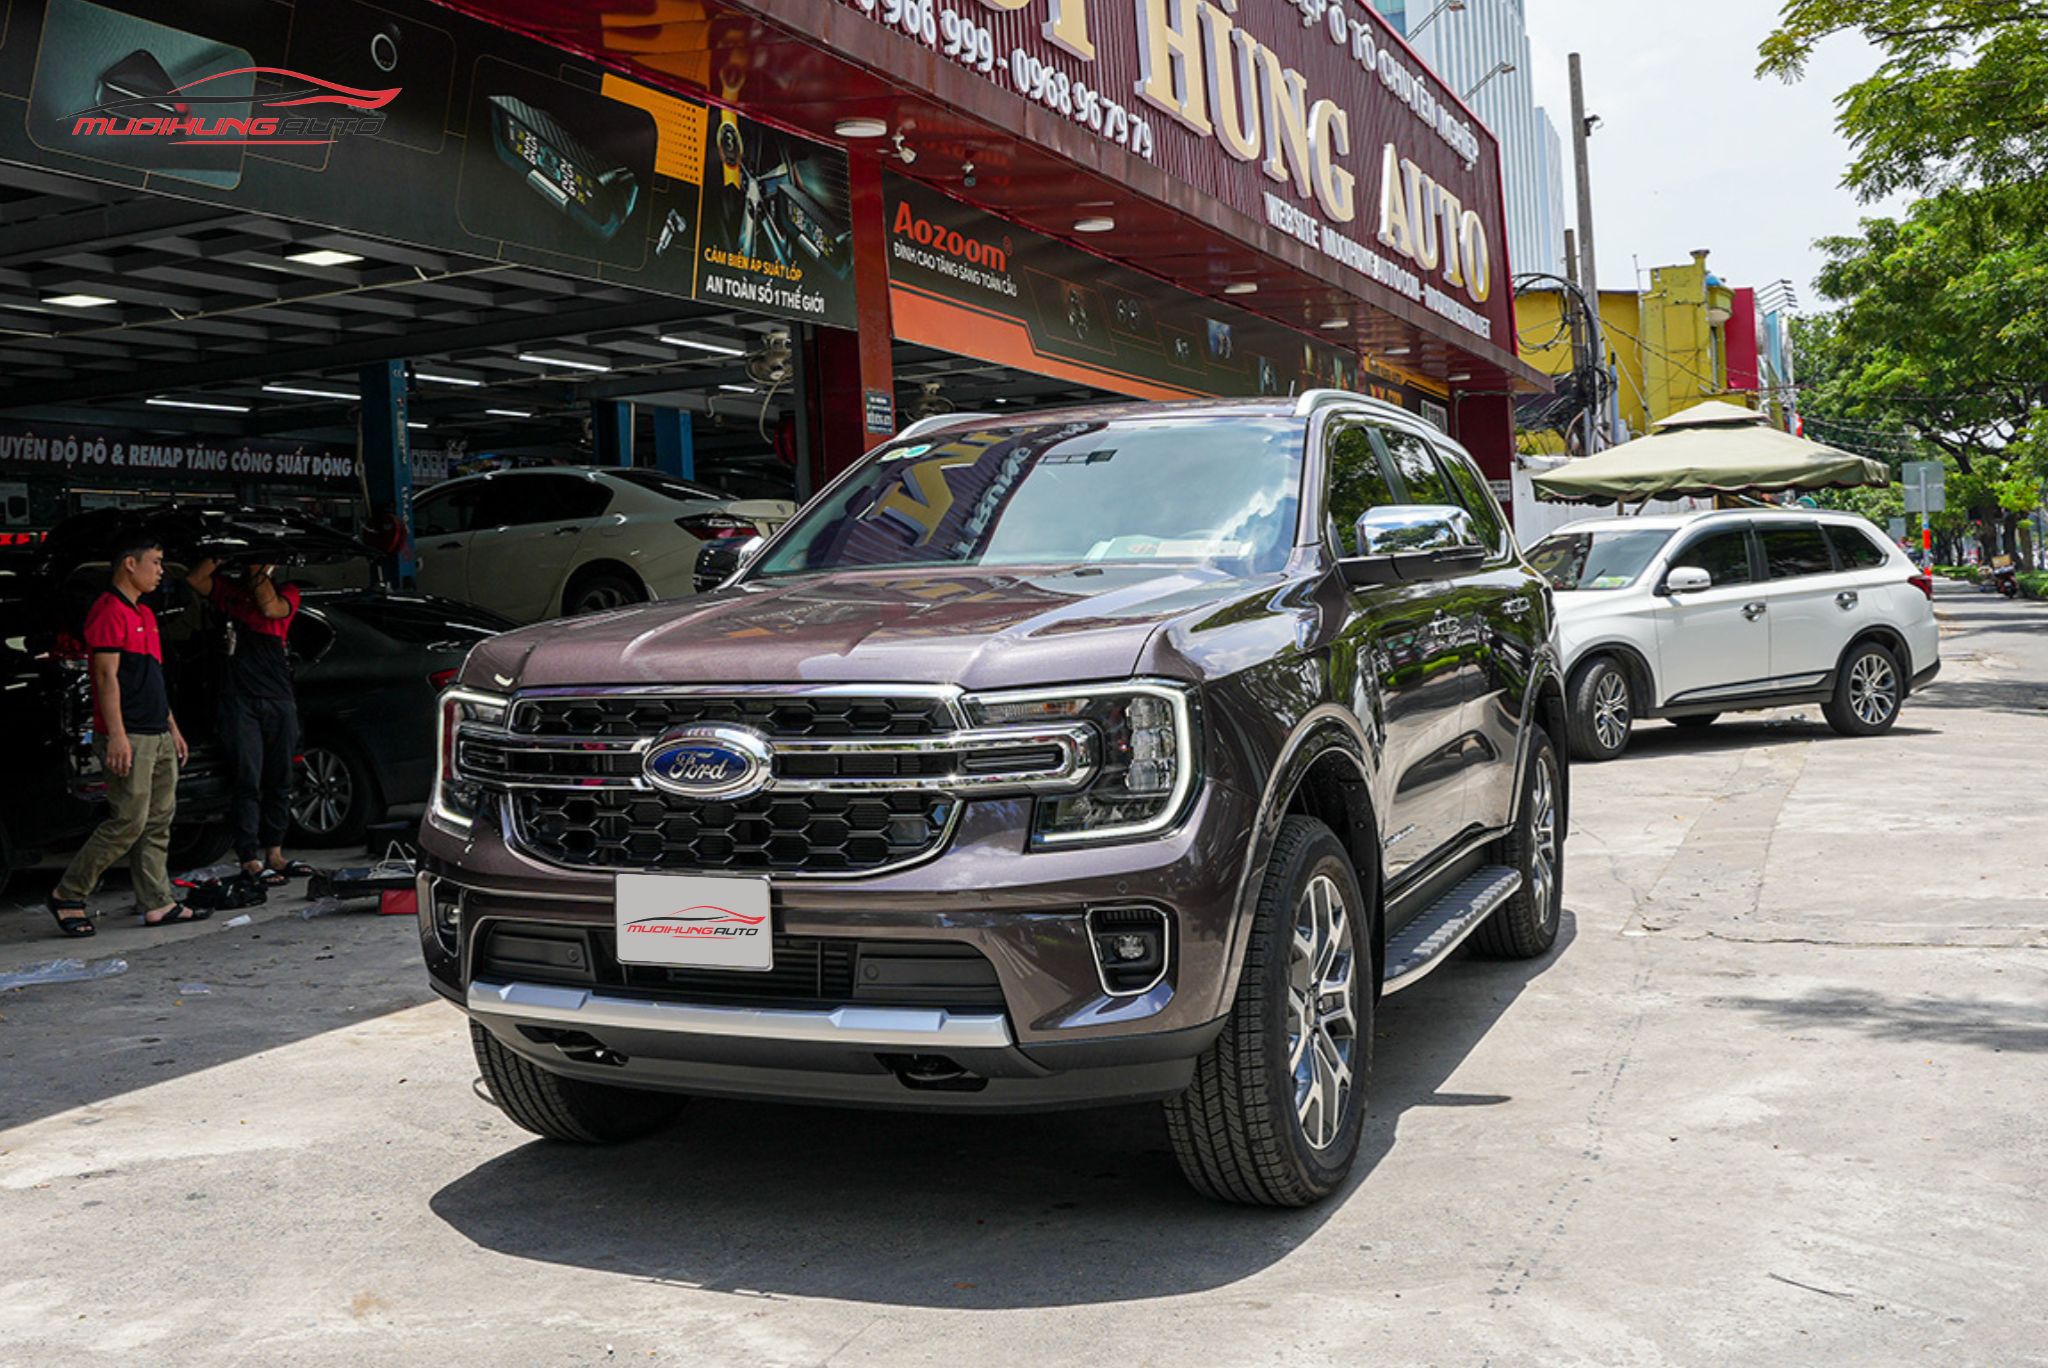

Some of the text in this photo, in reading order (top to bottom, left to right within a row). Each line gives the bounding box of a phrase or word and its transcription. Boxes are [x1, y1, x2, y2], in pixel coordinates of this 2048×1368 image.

[940, 8, 994, 73] 999
[1010, 47, 1071, 117] 0968
[1348, 18, 1377, 71] TÔ
[1378, 142, 1491, 303] AUTO
[705, 274, 724, 295] AN
[725, 275, 757, 301] TOÀN
[757, 278, 773, 304] SỐ
[780, 284, 802, 310] THẾ
[802, 290, 825, 314] GIỚI
[50, 434, 78, 469] ĐỘ
[81, 436, 107, 464] PÔ
[110, 443, 125, 466] &
[128, 444, 183, 468] REMAP
[186, 443, 227, 471] TĂNG
[231, 447, 273, 473] CÔNG
[276, 446, 309, 475] SUẤT
[312, 452, 352, 482] ĐỘNG
[669, 751, 728, 781] Ford
